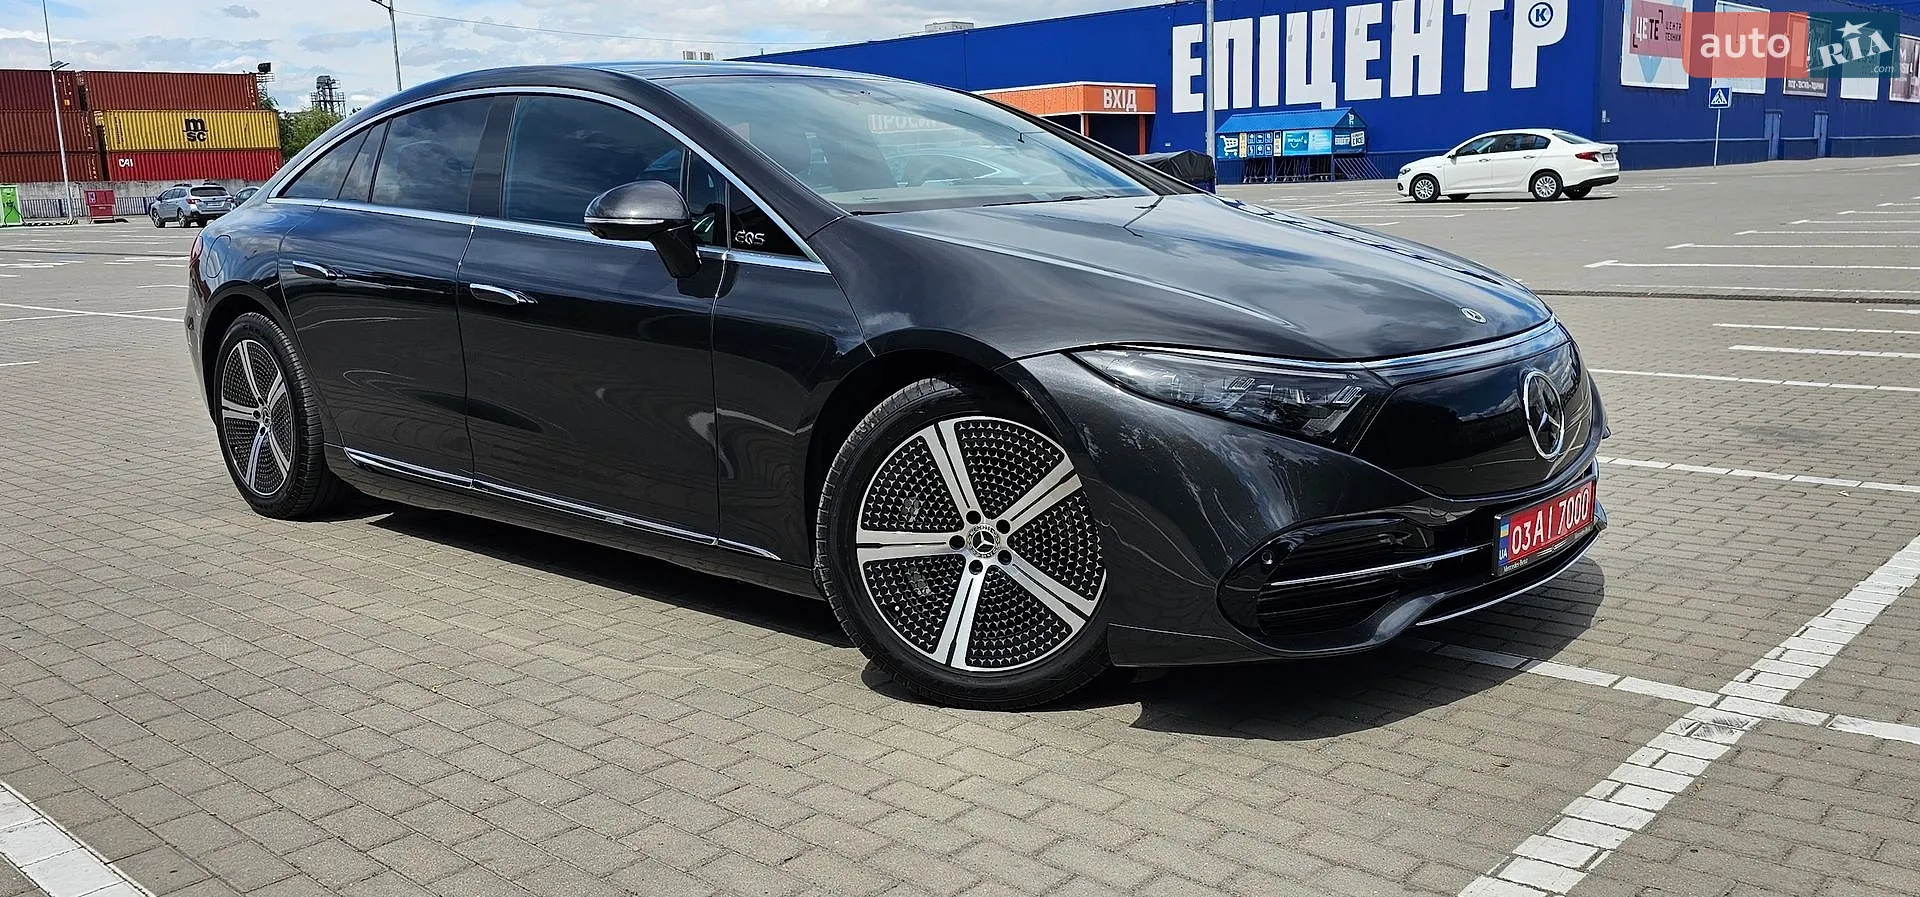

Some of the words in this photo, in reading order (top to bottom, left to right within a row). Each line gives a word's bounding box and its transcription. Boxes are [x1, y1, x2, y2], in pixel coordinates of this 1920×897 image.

[1636, 16, 1659, 41] ЦЕТЕ
[1172, 0, 1568, 113] ЕПІЦЕНТР
[1103, 88, 1137, 112] ВХІД
[735, 229, 765, 245] EQS
[1499, 548, 1508, 560] UA
[1558, 489, 1589, 535] 7000
